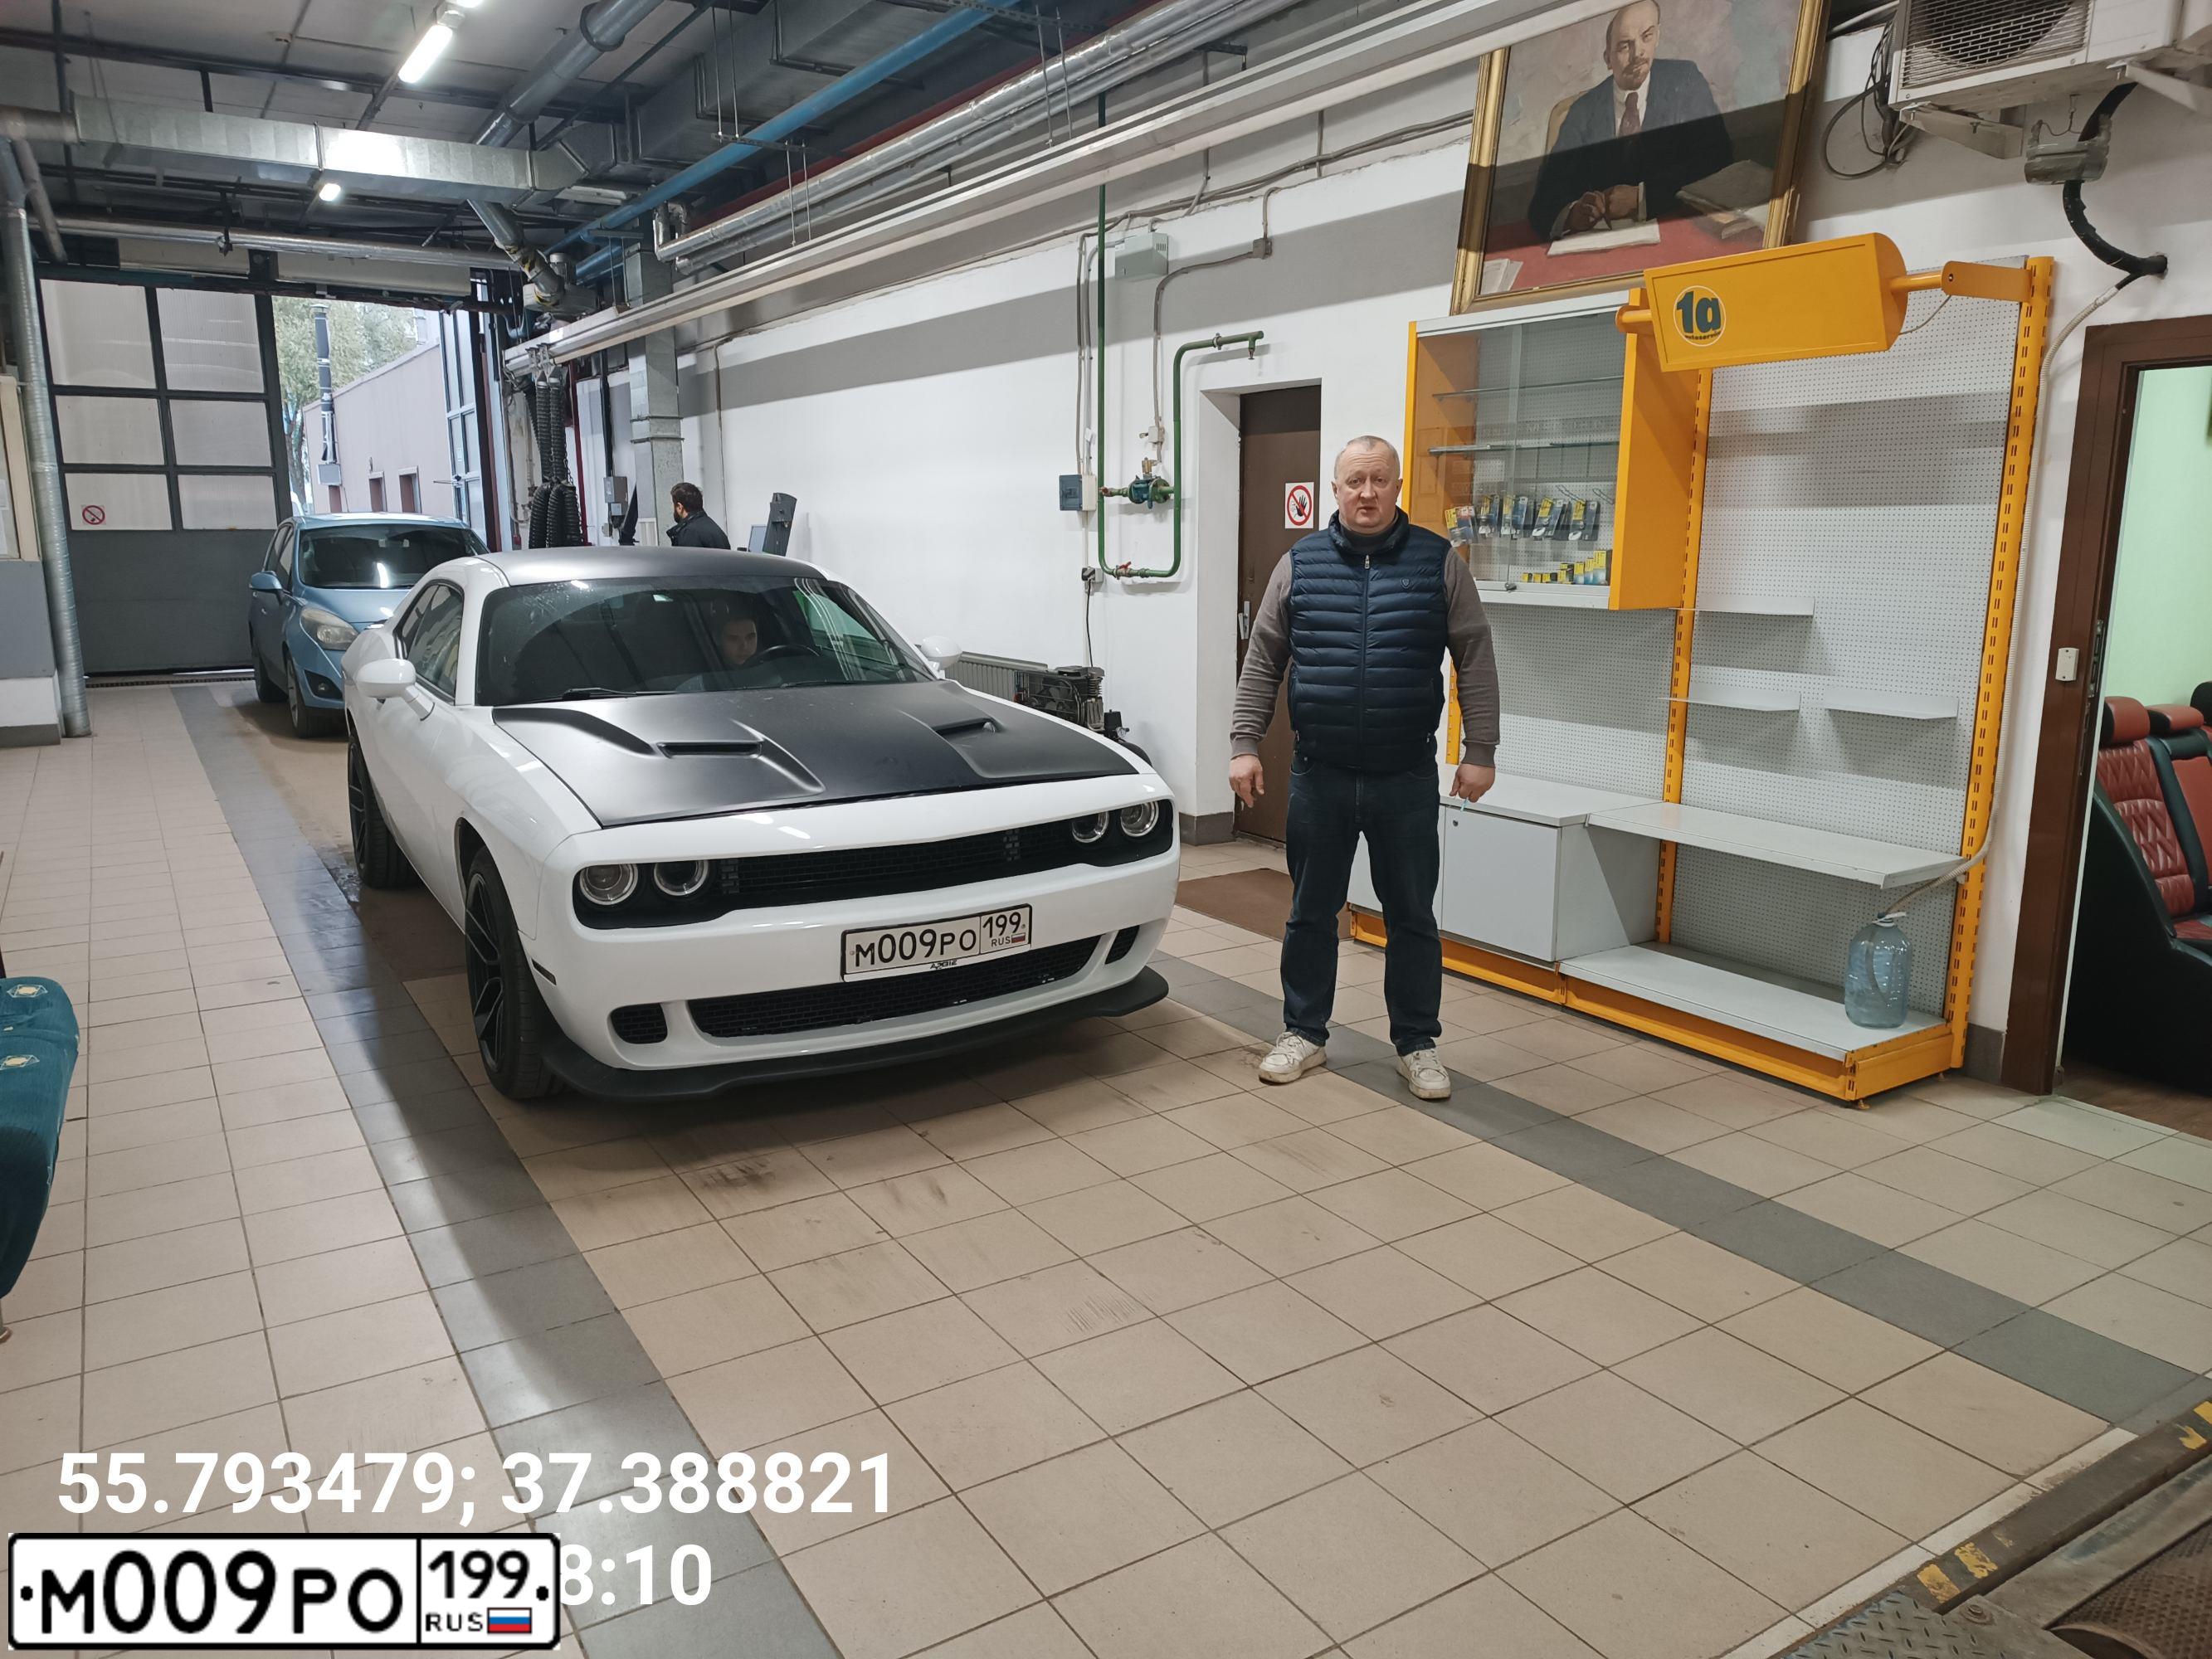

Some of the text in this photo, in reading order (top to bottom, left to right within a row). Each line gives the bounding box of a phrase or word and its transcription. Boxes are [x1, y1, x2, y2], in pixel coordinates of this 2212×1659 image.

[1676, 290, 1722, 333] 1a
[855, 912, 1022, 967] М009РО 199
[991, 936, 1011, 947] RUS
